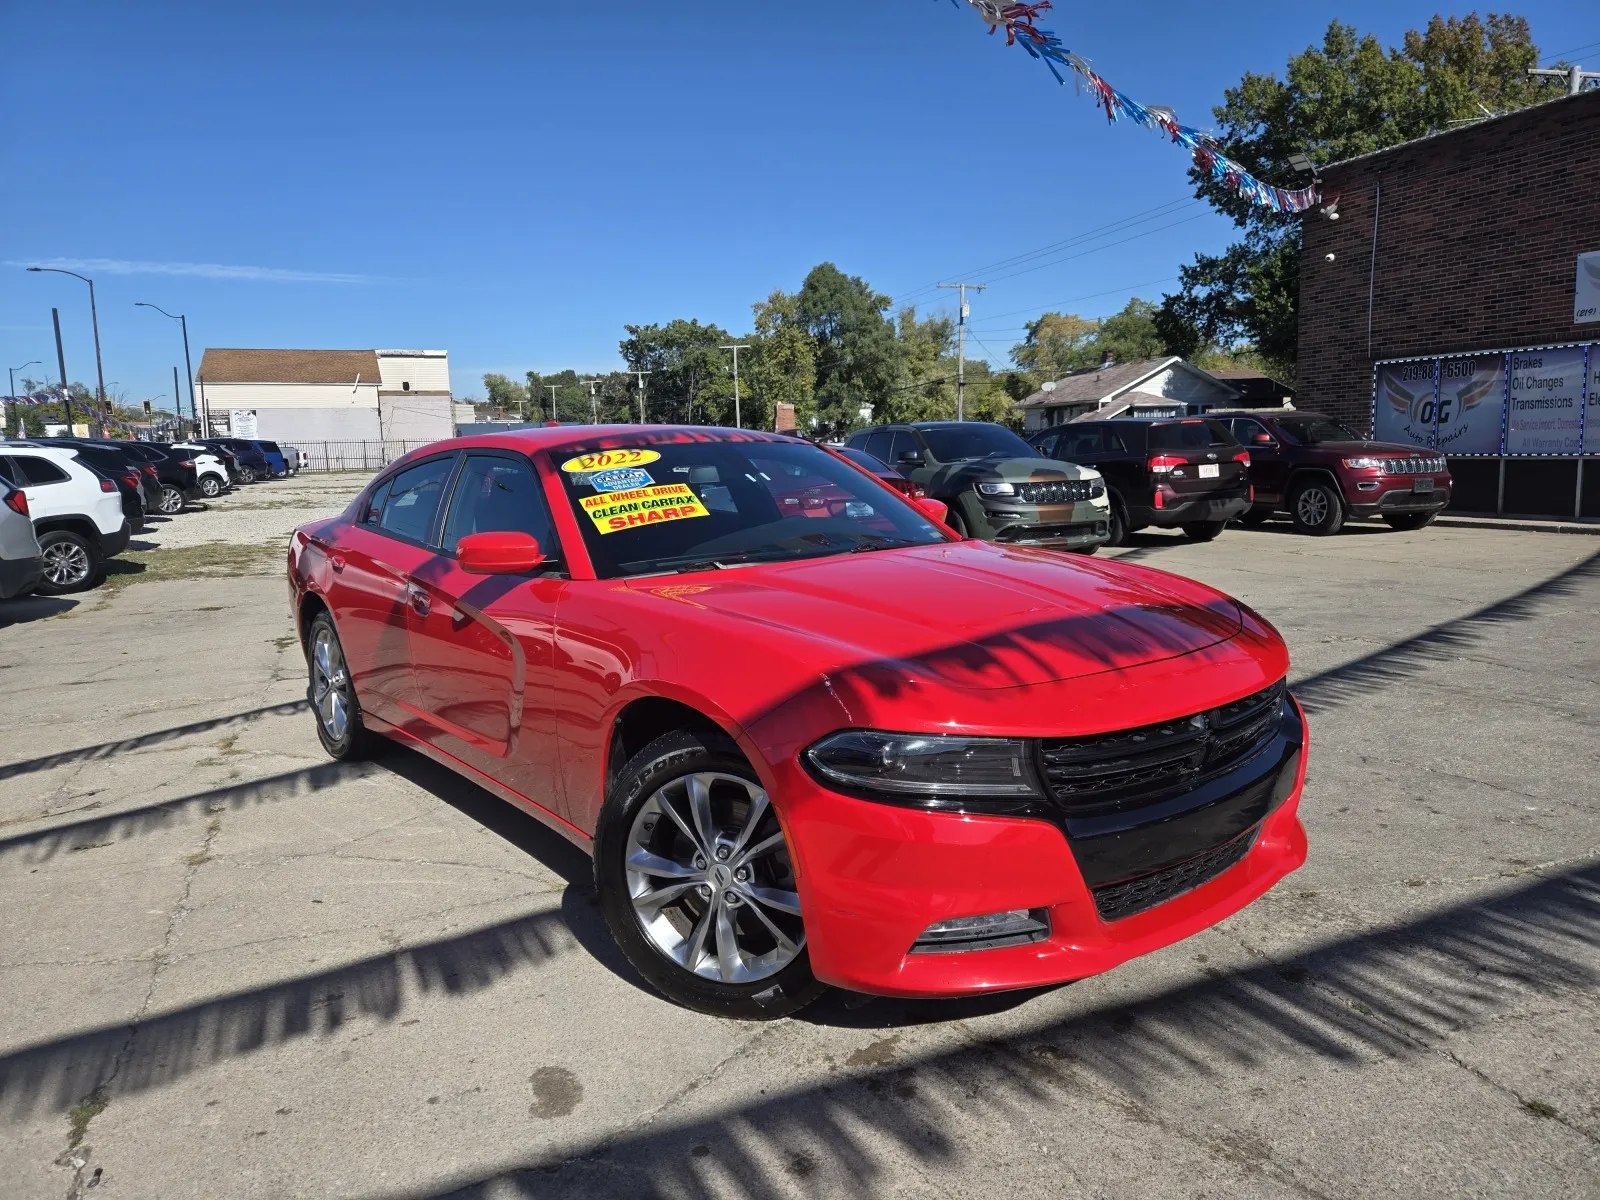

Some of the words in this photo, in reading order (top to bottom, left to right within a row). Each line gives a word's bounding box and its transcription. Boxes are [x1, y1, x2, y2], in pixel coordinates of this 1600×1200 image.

[1576, 308, 1597, 317] (219)
[1513, 356, 1543, 370] Brakes
[1512, 376, 1524, 390] Oil
[1526, 376, 1564, 391] Changes
[1511, 396, 1573, 411] Transmissions
[1420, 400, 1452, 424] OG
[1403, 425, 1424, 444] Auto
[1532, 438, 1563, 450] Warranty
[583, 451, 642, 469] 2022
[603, 478, 645, 487] ADVANTAGE
[585, 496, 607, 508] ALL
[609, 490, 650, 501] WHEEL
[652, 485, 686, 496] DRIVE
[592, 503, 640, 519] CLEAN
[641, 495, 696, 509] CARFAX
[608, 506, 697, 529] SHARP
